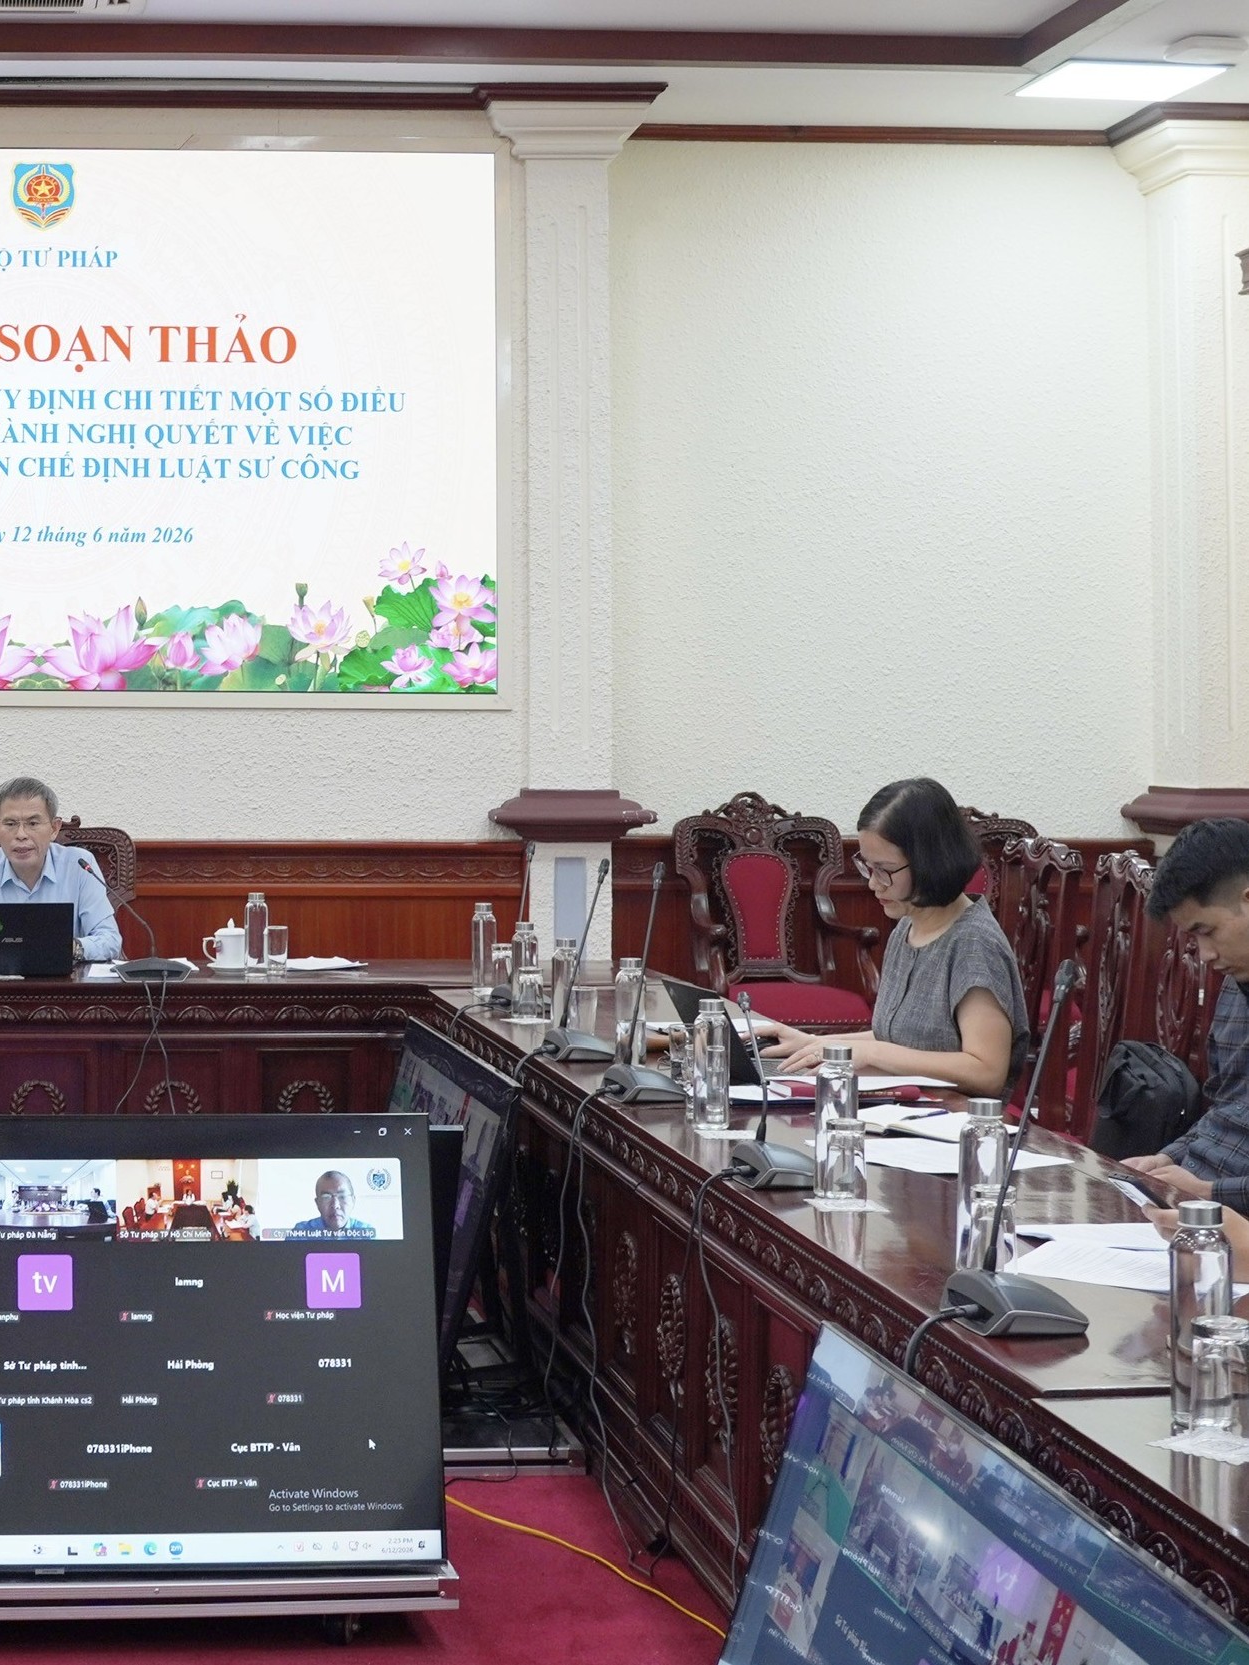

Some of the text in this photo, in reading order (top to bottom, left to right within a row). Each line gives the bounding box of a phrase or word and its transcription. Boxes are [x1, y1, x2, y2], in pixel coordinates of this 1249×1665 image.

[17, 246, 52, 267] TƯ
[57, 246, 119, 268] PHÁP
[149, 313, 298, 365] THẢO
[27, 389, 97, 415] ĐỊNH
[103, 389, 153, 411] CHI
[160, 384, 223, 411] TIẾT
[230, 387, 292, 417] MỘT
[299, 386, 334, 412] SỐ
[340, 386, 406, 412] ĐIỀU
[67, 423, 137, 449] NGHỊ
[144, 418, 239, 449] QUYẾT
[245, 418, 281, 445] VỀ
[287, 422, 353, 451] VIỆC
[18, 451, 75, 478] CHẾ
[82, 457, 151, 483] ĐỊNH
[159, 455, 232, 483] LUẬT
[238, 456, 276, 478] SƯ
[281, 453, 360, 479] CÔNG
[12, 526, 32, 542] 12
[37, 525, 87, 547] tháng
[93, 526, 103, 543] 6
[108, 528, 146, 543] năm
[151, 527, 194, 544] 2026
[7, 1231, 24, 1240] pháp
[141, 1231, 158, 1239] pháp
[32, 1272, 57, 1293] tv
[175, 1277, 203, 1288] lamng
[321, 1269, 345, 1292] M
[131, 1313, 152, 1322] lamng
[4, 1361, 16, 1370] Sở
[18, 1361, 31, 1370] Tư
[34, 1360, 57, 1372] pháp
[167, 1359, 214, 1371] Hải Phòng
[318, 1359, 351, 1368] 078331
[122, 1395, 157, 1405] Hải Phòng
[278, 1394, 302, 1403] 078331
[86, 1444, 153, 1453] 078331iPhone
[231, 1443, 248, 1454] Cục
[250, 1443, 274, 1452] BTTP
[60, 1480, 107, 1488] 078331iPhone
[221, 1479, 237, 1487] BTTP
[269, 1488, 359, 1499] Activate Windows
[269, 1503, 280, 1511] Go
[293, 1503, 323, 1513] Settings
[366, 1502, 404, 1510] Windows.
